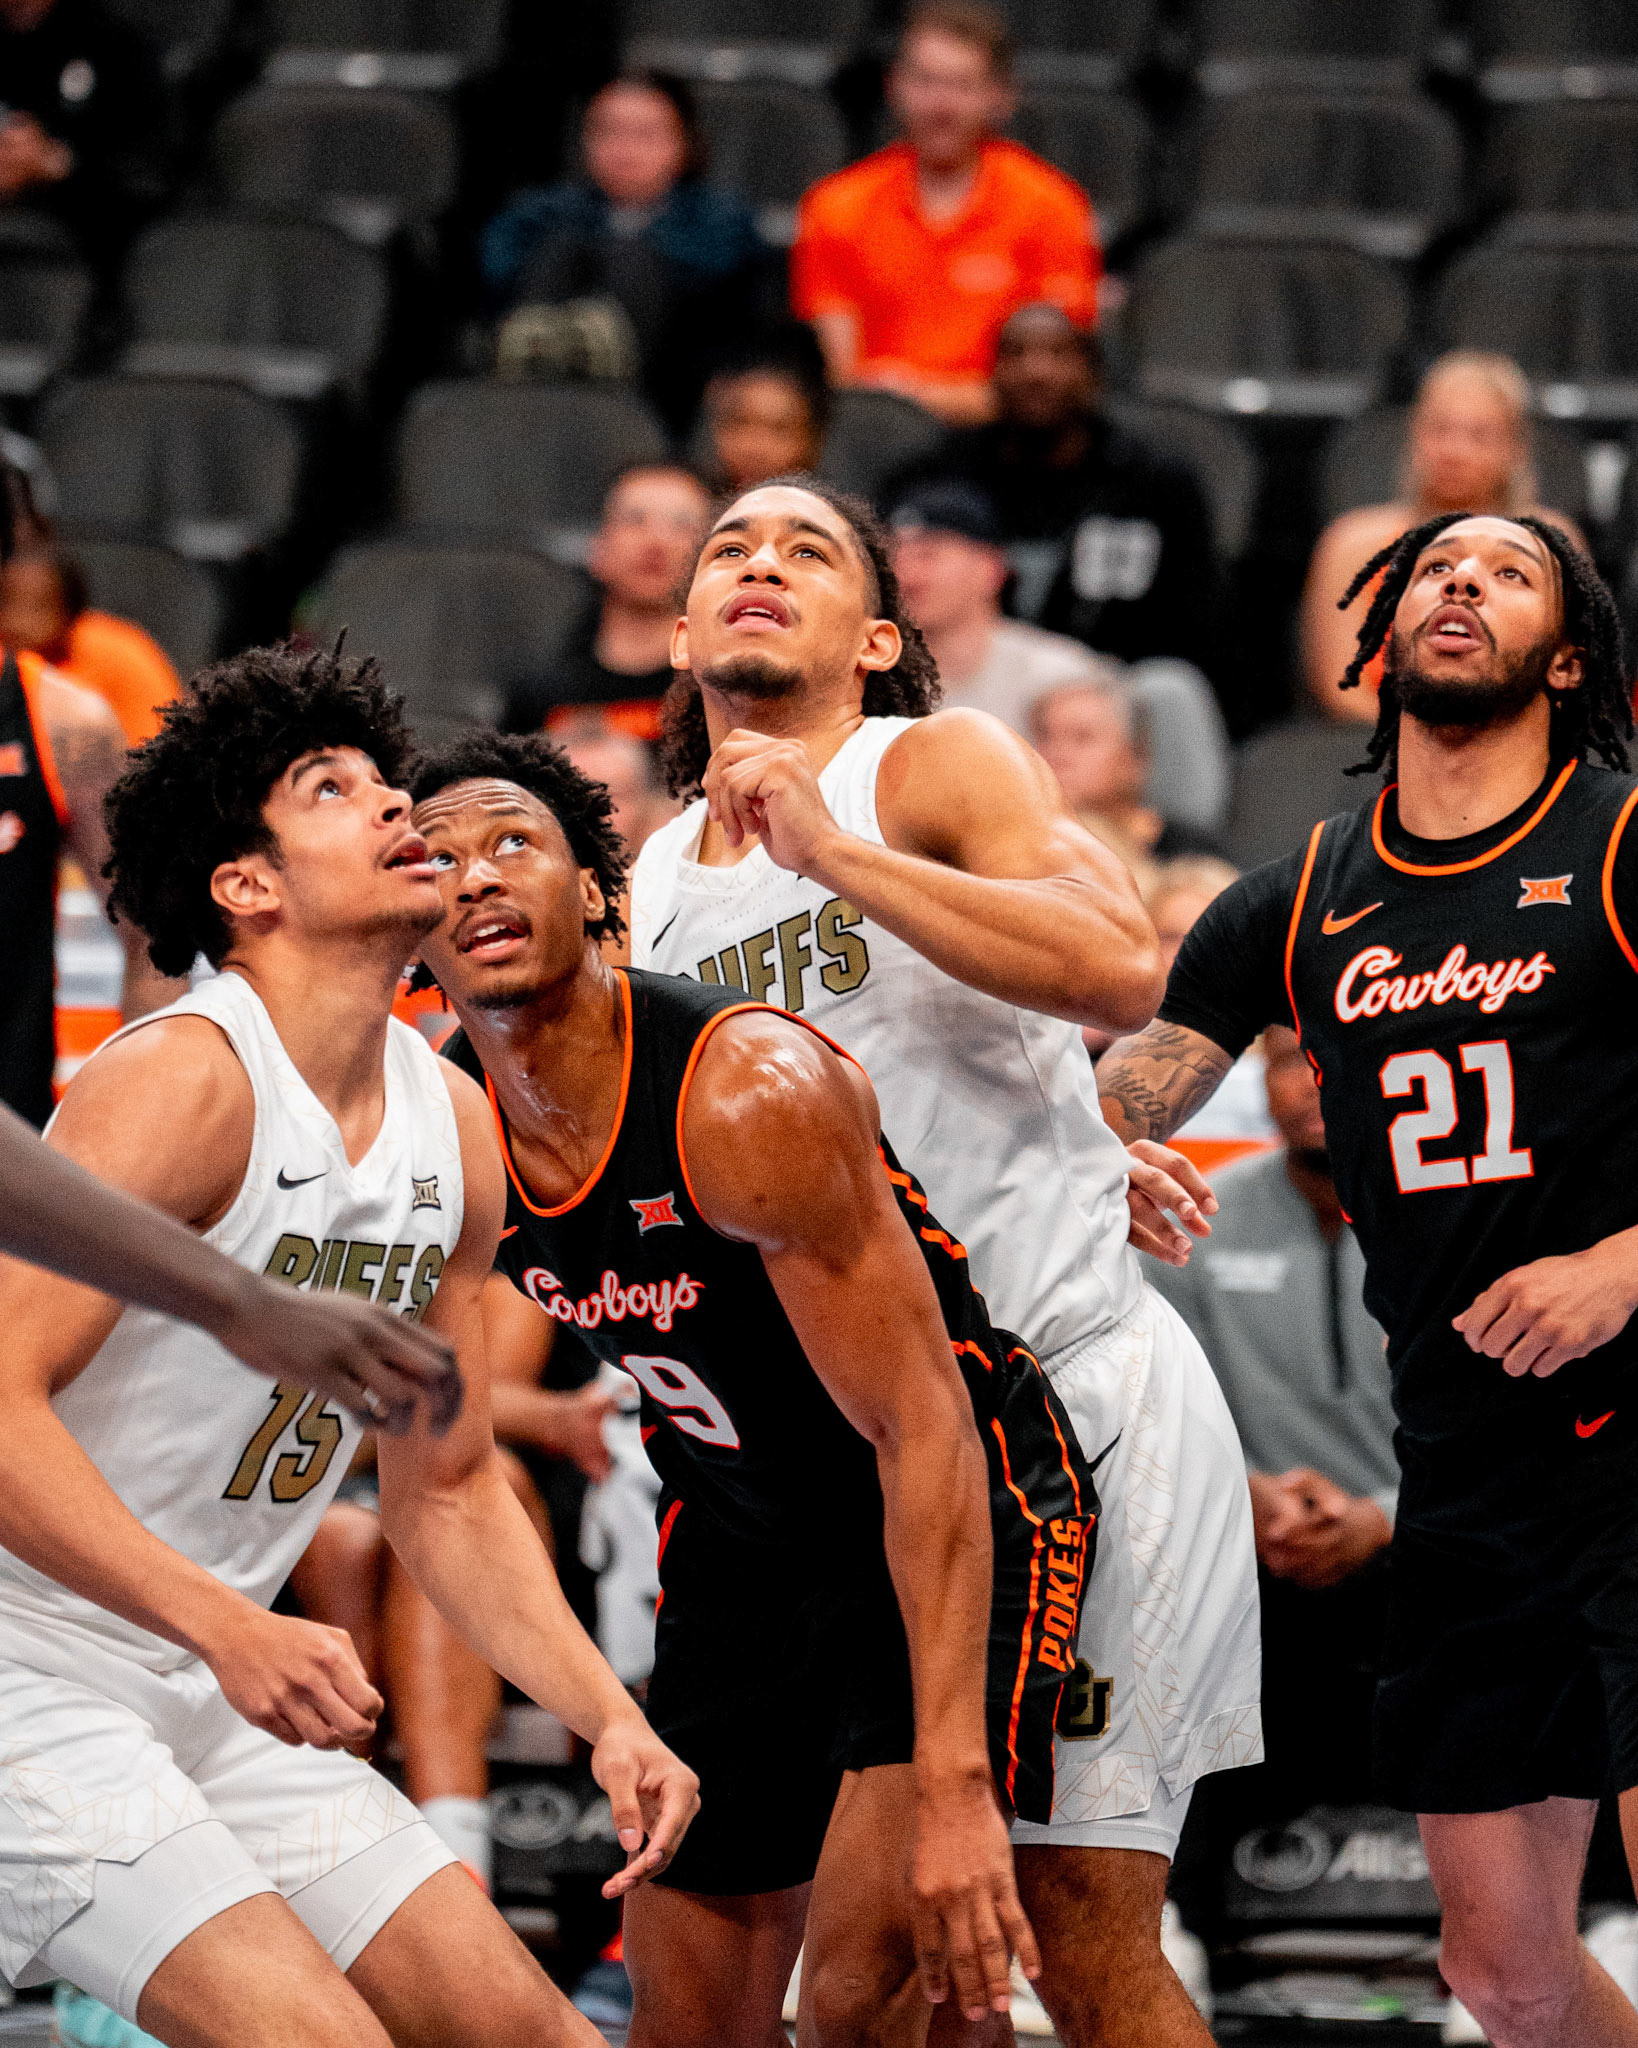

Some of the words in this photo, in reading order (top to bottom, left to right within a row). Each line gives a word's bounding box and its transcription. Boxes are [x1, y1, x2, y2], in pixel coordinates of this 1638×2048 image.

[1334, 944, 1556, 1023] Cowboys
[1379, 1039, 1534, 1194] 21
[632, 1196, 681, 1230] XII
[523, 1267, 706, 1333] Cowboys
[221, 1382, 343, 1503] 15
[621, 1354, 740, 1450] 9
[1037, 1518, 1083, 1673] POKES
